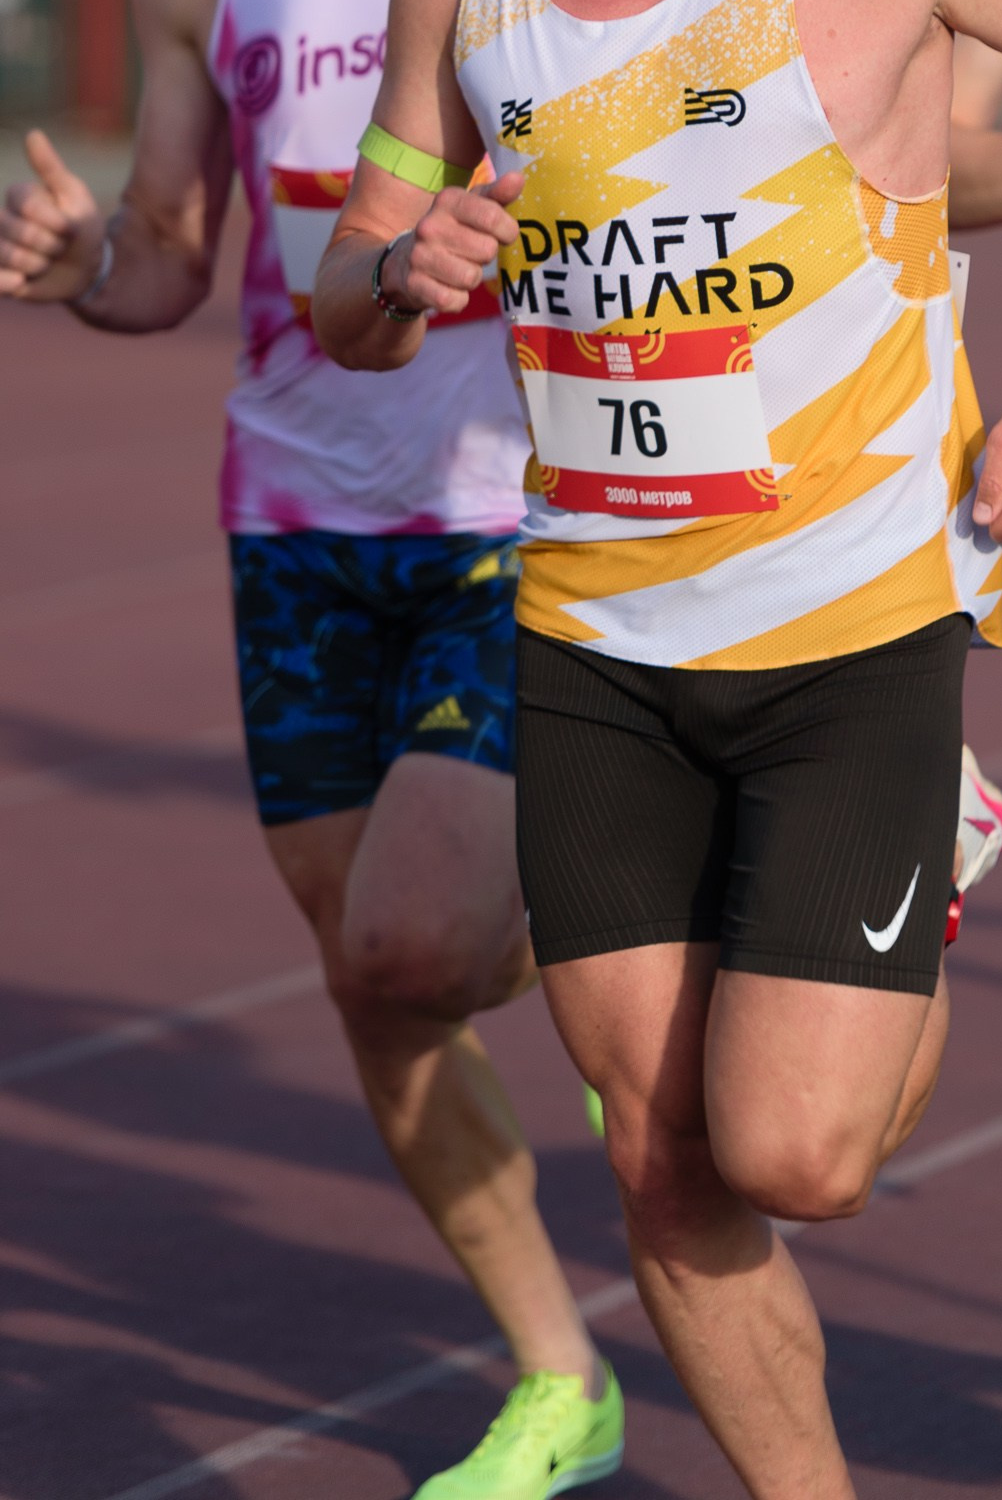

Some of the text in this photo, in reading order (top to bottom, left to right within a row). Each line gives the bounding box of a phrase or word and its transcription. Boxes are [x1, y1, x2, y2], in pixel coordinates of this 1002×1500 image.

[516, 211, 738, 267] DRAFT
[501, 262, 795, 320] ME HARD
[597, 397, 669, 458] 76
[604, 486, 693, 509] 3000 метров
